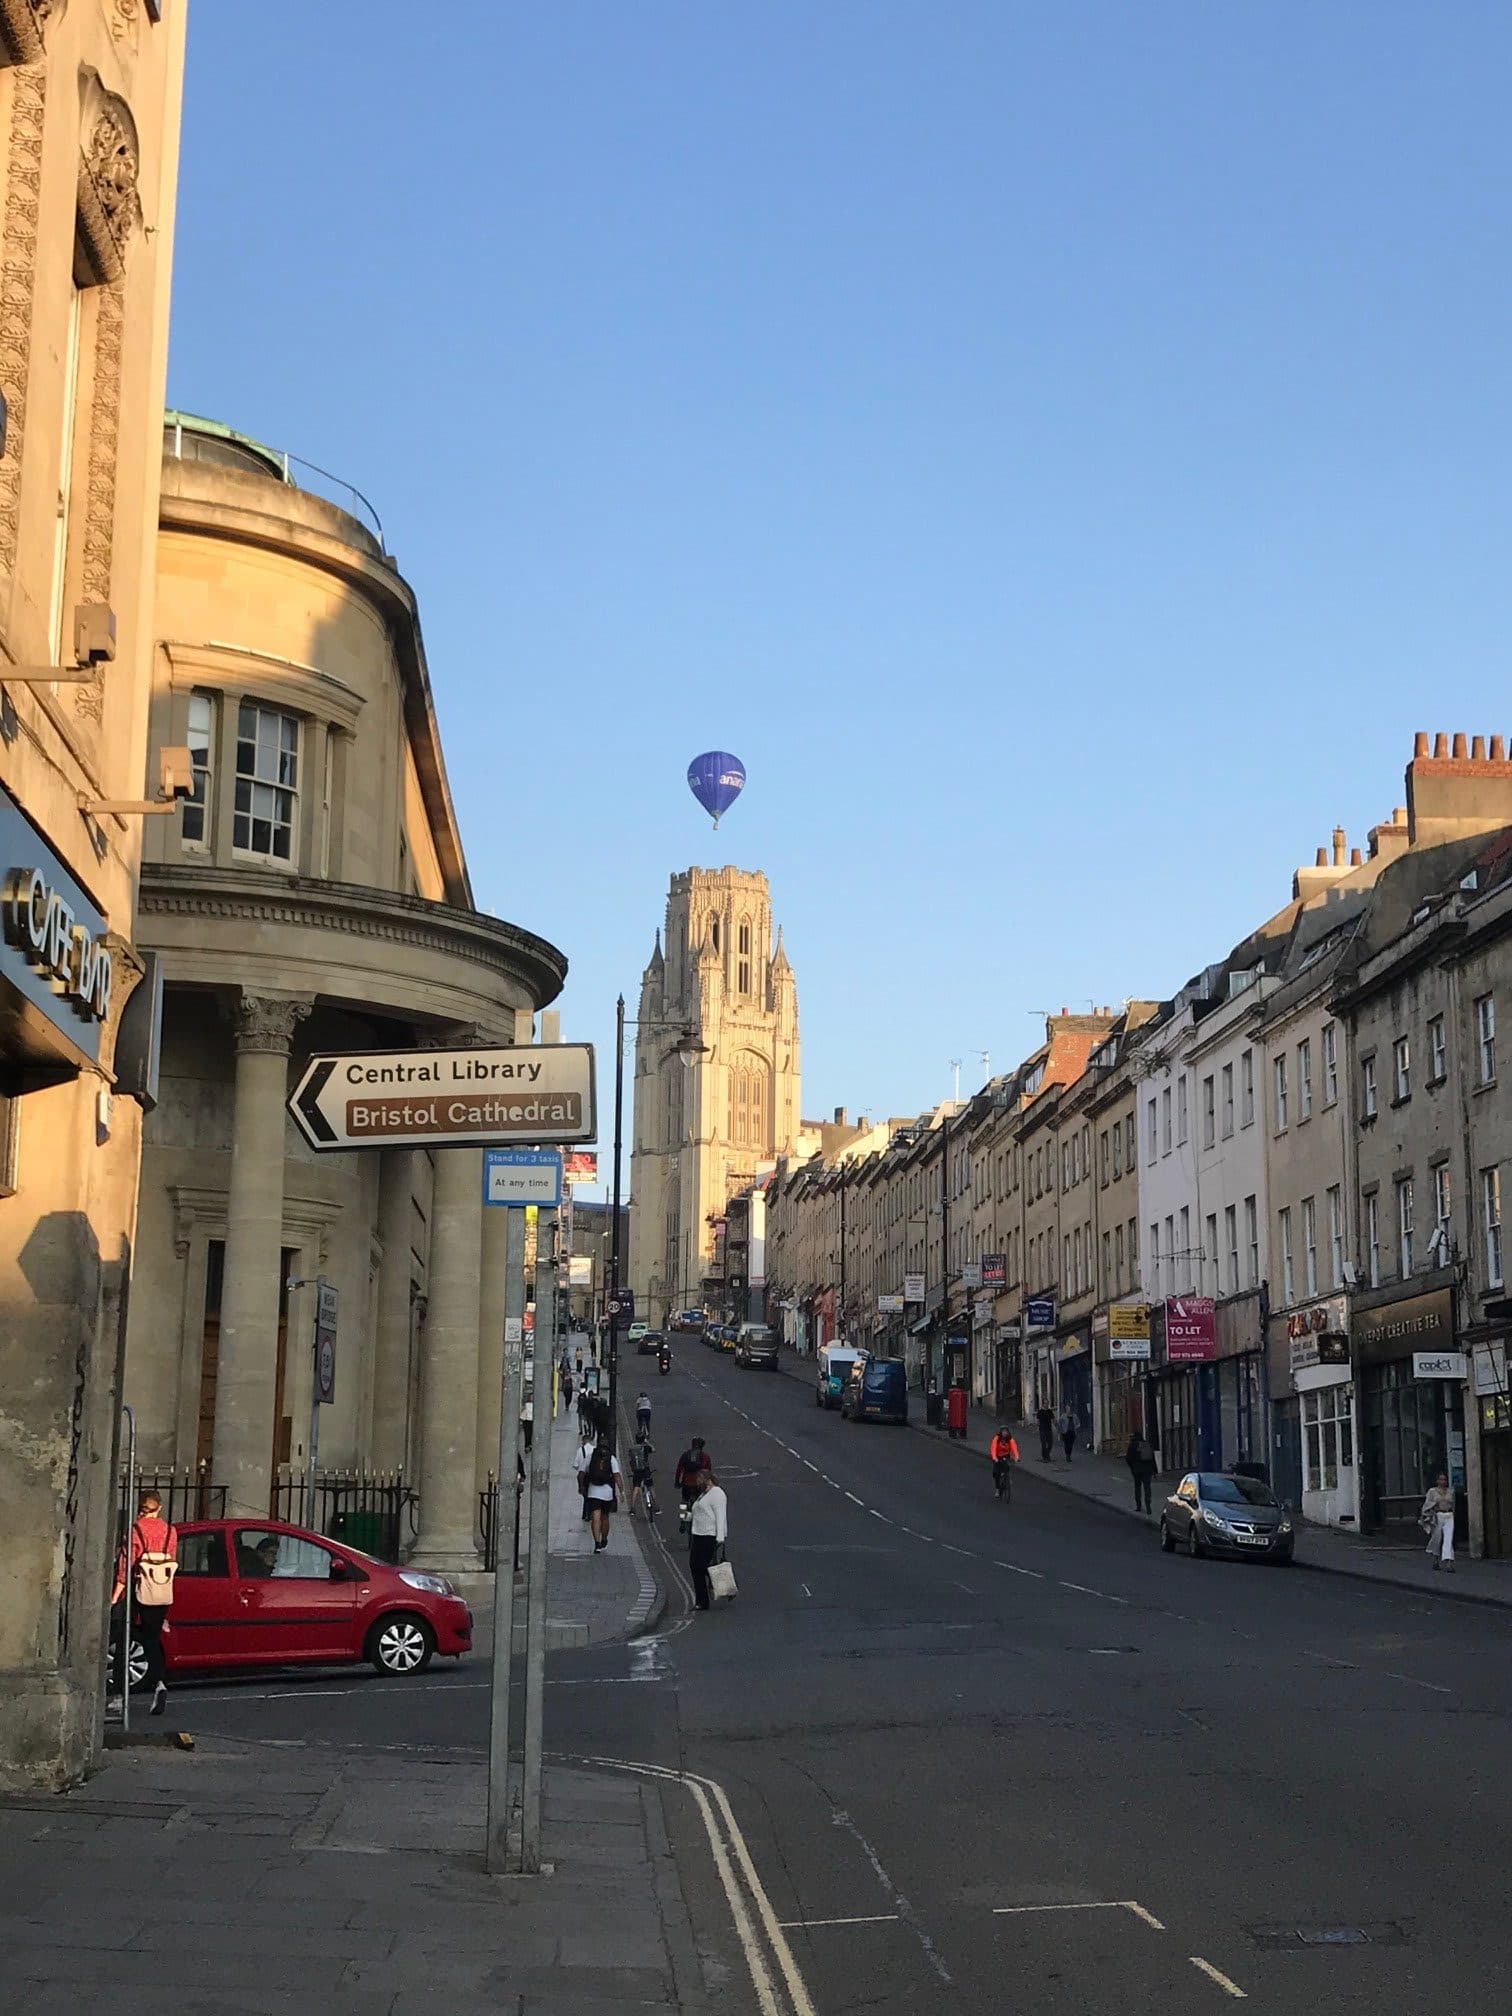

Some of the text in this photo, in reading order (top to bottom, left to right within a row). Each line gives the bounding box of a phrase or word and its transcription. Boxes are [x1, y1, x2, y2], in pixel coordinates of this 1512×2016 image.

[28, 867, 112, 1021] CAFE BAR
[346, 1060, 542, 1085] Central Library
[352, 1099, 575, 1127] Bristol Cathedral
[487, 1153, 560, 1163] Stand for 3 taxis
[495, 1178, 549, 1188] At any time
[608, 1303, 620, 1311] 20
[1424, 1314, 1441, 1329] TEA
[1169, 1326, 1202, 1335] TO LET
